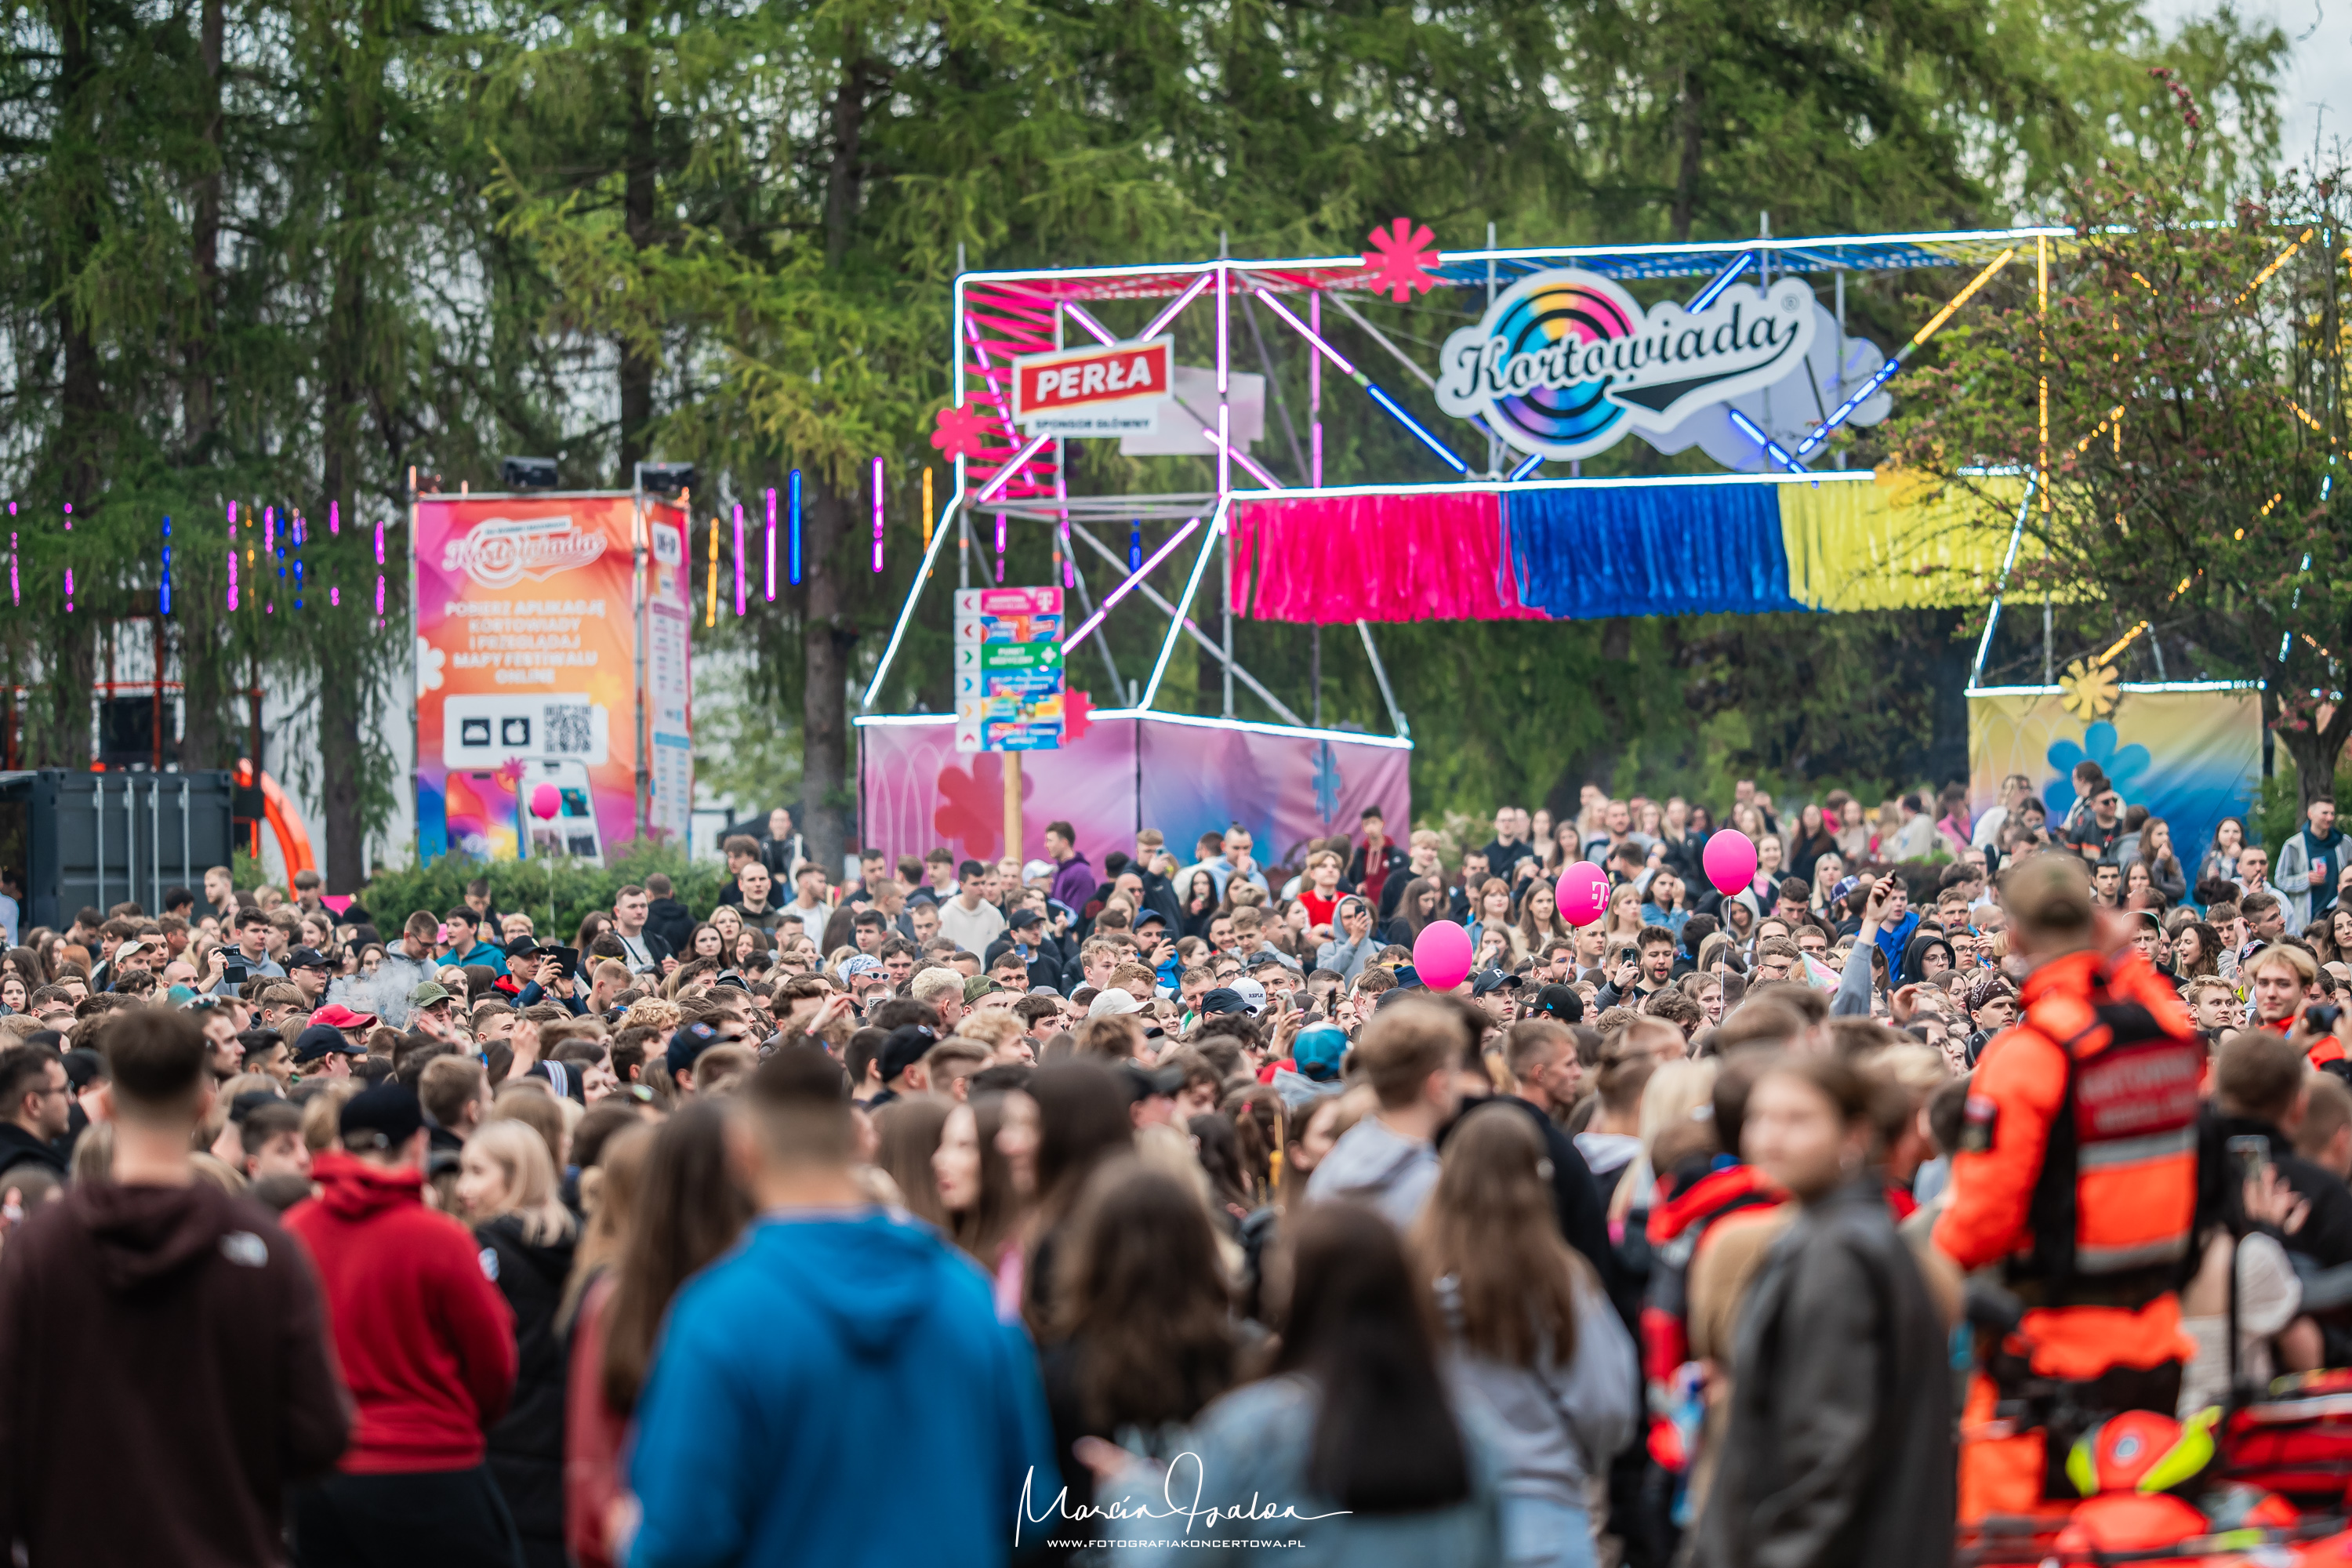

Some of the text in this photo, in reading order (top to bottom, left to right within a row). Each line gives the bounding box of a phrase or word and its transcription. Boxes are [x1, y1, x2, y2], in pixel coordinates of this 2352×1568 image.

[1453, 302, 1783, 401] Kortowiada
[1035, 356, 1152, 403] PERŁA
[1035, 416, 1151, 429] SPONSOR GŁÓWNY
[443, 527, 607, 572] Kortowiada
[445, 600, 606, 618] POBIERZ APLIKACJĘ
[468, 618, 582, 633] KORTOWIADY
[469, 635, 581, 652] I PRZEGLĄDAJ
[453, 652, 598, 668] MAPY FESTIWALU
[495, 669, 556, 684] ONLINE
